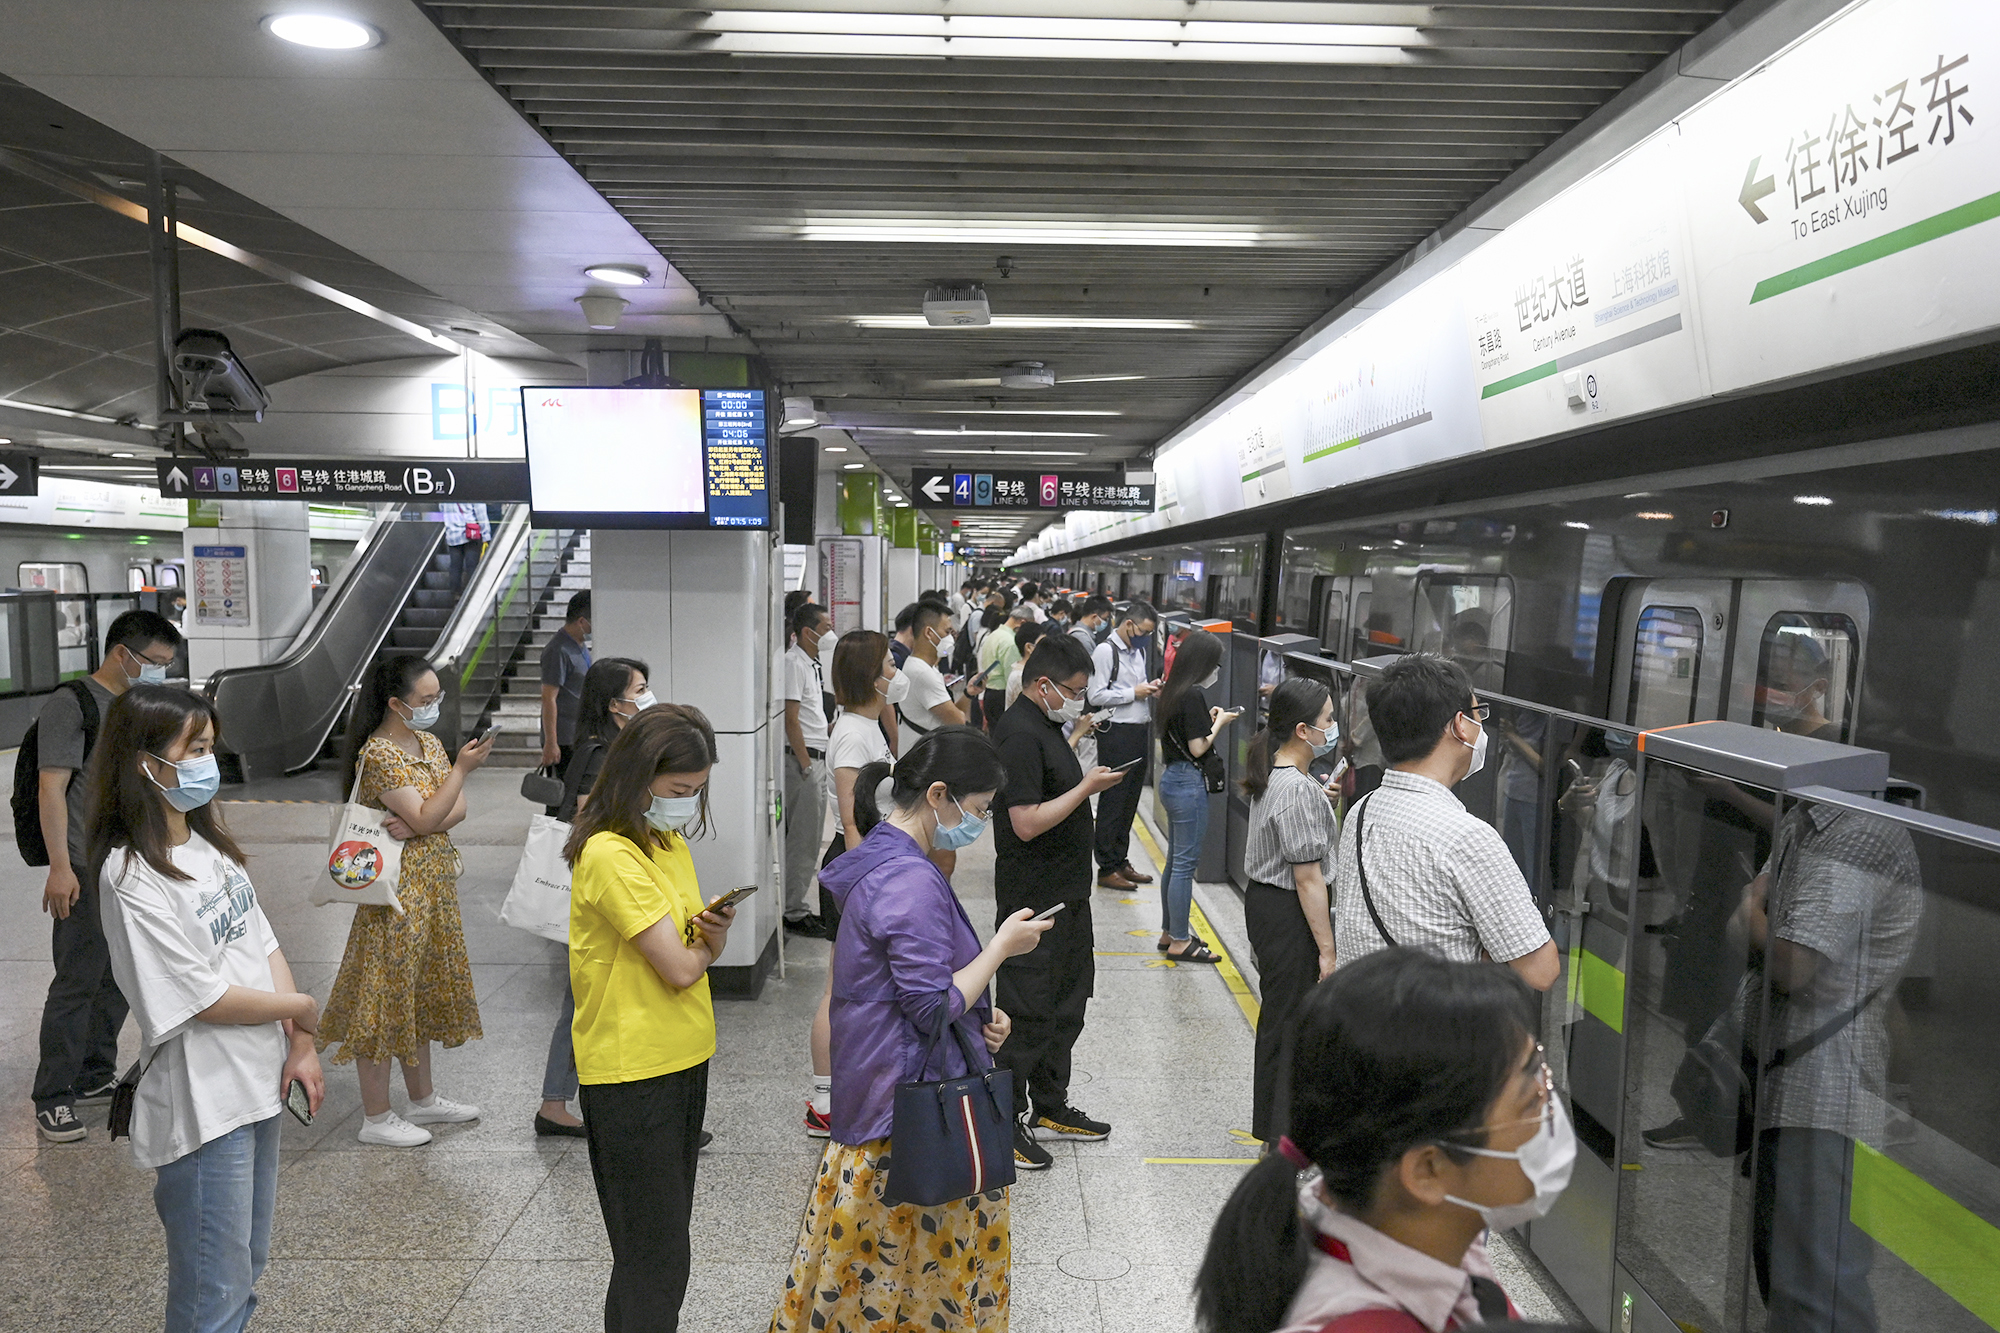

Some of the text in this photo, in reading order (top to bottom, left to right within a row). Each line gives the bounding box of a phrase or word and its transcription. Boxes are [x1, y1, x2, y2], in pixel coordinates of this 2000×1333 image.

[1785, 54, 1975, 211] 往徐泾东
[1791, 187, 1888, 240] To East Xujing
[1611, 248, 1672, 299] 上海科技馆
[1514, 253, 1590, 332] 世纪大道
[1594, 307, 1613, 324] Shanghai
[1613, 302, 1630, 318] Science
[1633, 291, 1658, 311] Technology
[1657, 284, 1678, 300] Museum
[1478, 327, 1502, 357] 东昌路
[1532, 325, 1576, 353] Century Avenue
[1481, 351, 1510, 371] Dongchang Road
[721, 400, 747, 409] 00:00
[722, 430, 748, 438] 04:06
[200, 472, 209, 486] 4
[222, 473, 232, 486] 9
[240, 469, 271, 485] 号线
[282, 473, 292, 487] 6
[300, 469, 331, 485] 号线
[333, 469, 387, 484] 往港城路
[241, 484, 257, 492] Line
[335, 483, 344, 491] To
[344, 483, 384, 493] Gangcheng
[384, 483, 403, 491] Road
[956, 480, 969, 499] 4
[977, 480, 989, 499] 9
[995, 480, 1026, 497] 号线
[1042, 482, 1056, 501] 6
[1060, 481, 1090, 498] 号线
[1092, 486, 1141, 500] 往港城路
[994, 497, 1014, 505] LINE
[1099, 499, 1133, 507] Gangcheng
[535, 877, 560, 889] Embrace
